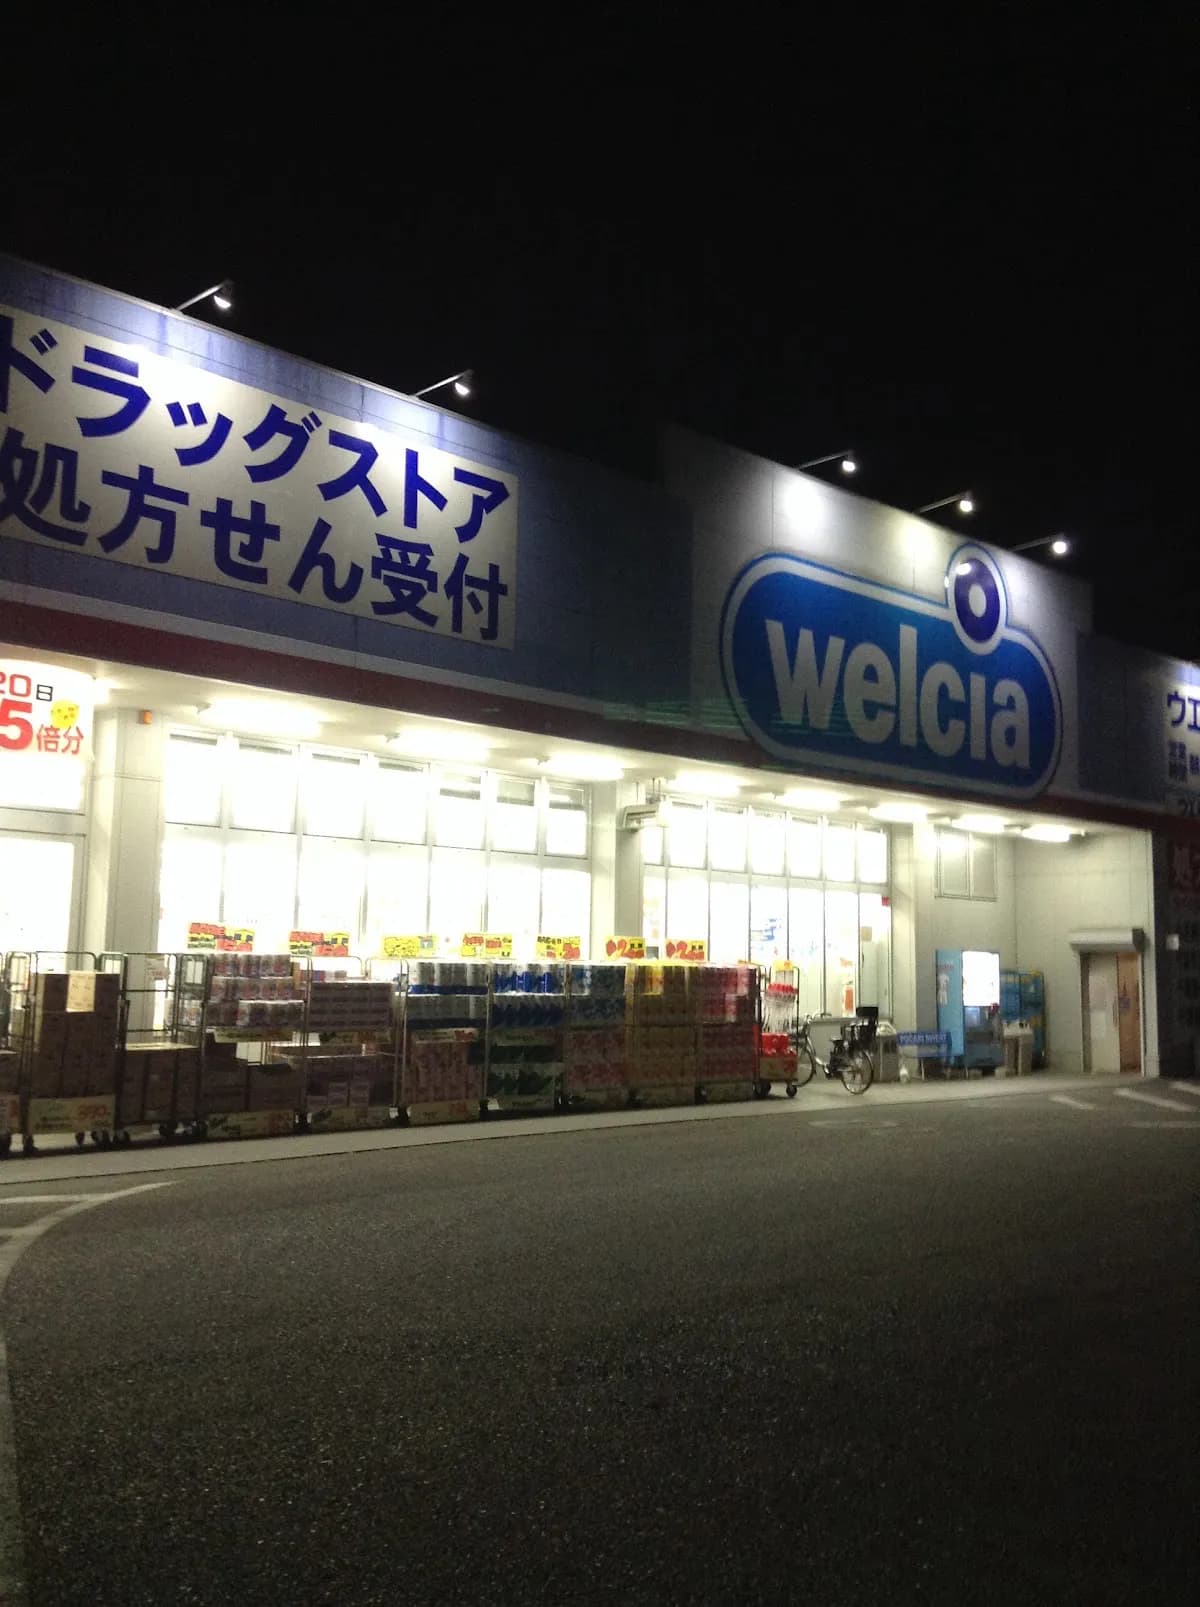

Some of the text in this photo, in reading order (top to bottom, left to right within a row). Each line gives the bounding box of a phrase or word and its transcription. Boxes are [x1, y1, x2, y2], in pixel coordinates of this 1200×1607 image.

[0, 314, 510, 544] ドラッグストア
[0, 426, 508, 641] 処方せん受付
[765, 557, 1031, 770] welcia
